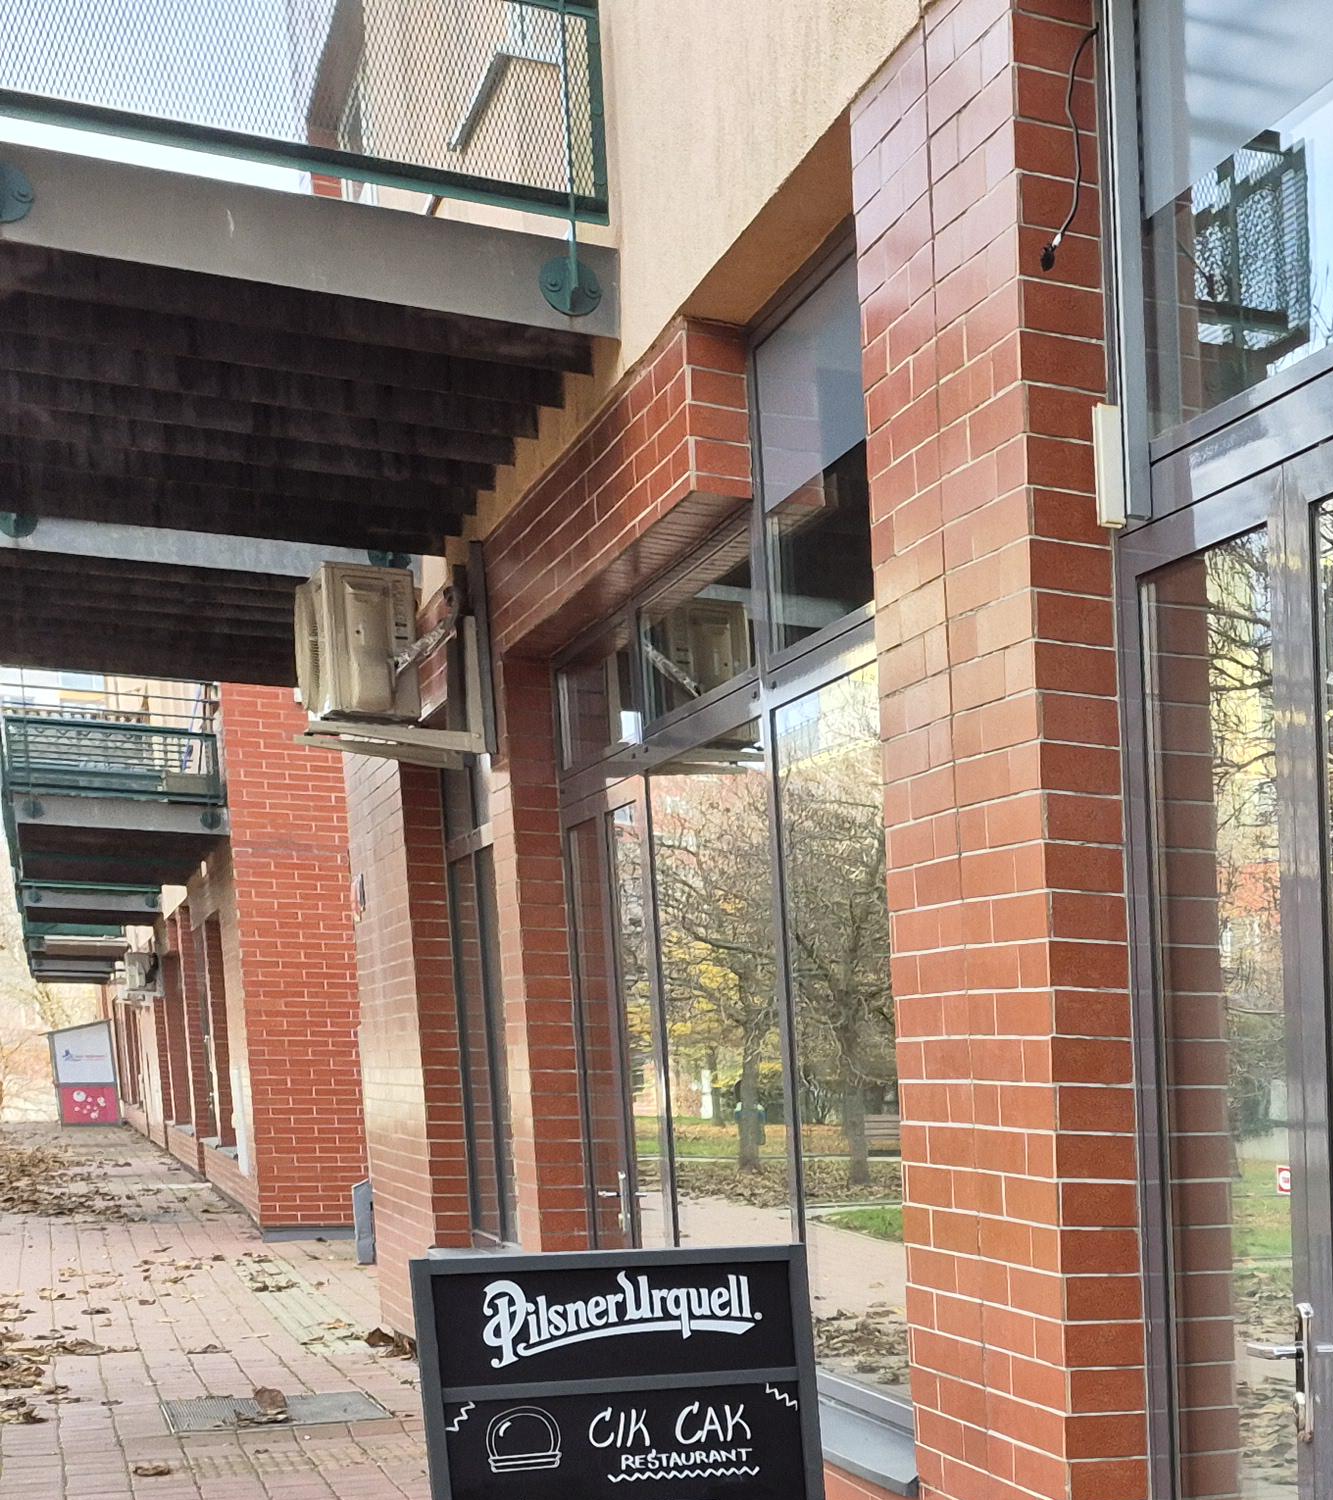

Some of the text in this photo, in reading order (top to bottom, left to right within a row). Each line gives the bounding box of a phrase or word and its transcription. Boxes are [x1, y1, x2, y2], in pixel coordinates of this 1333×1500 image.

[588, 1400, 752, 1449] CIK CAK
[620, 1447, 753, 1471] RESTAURANT
